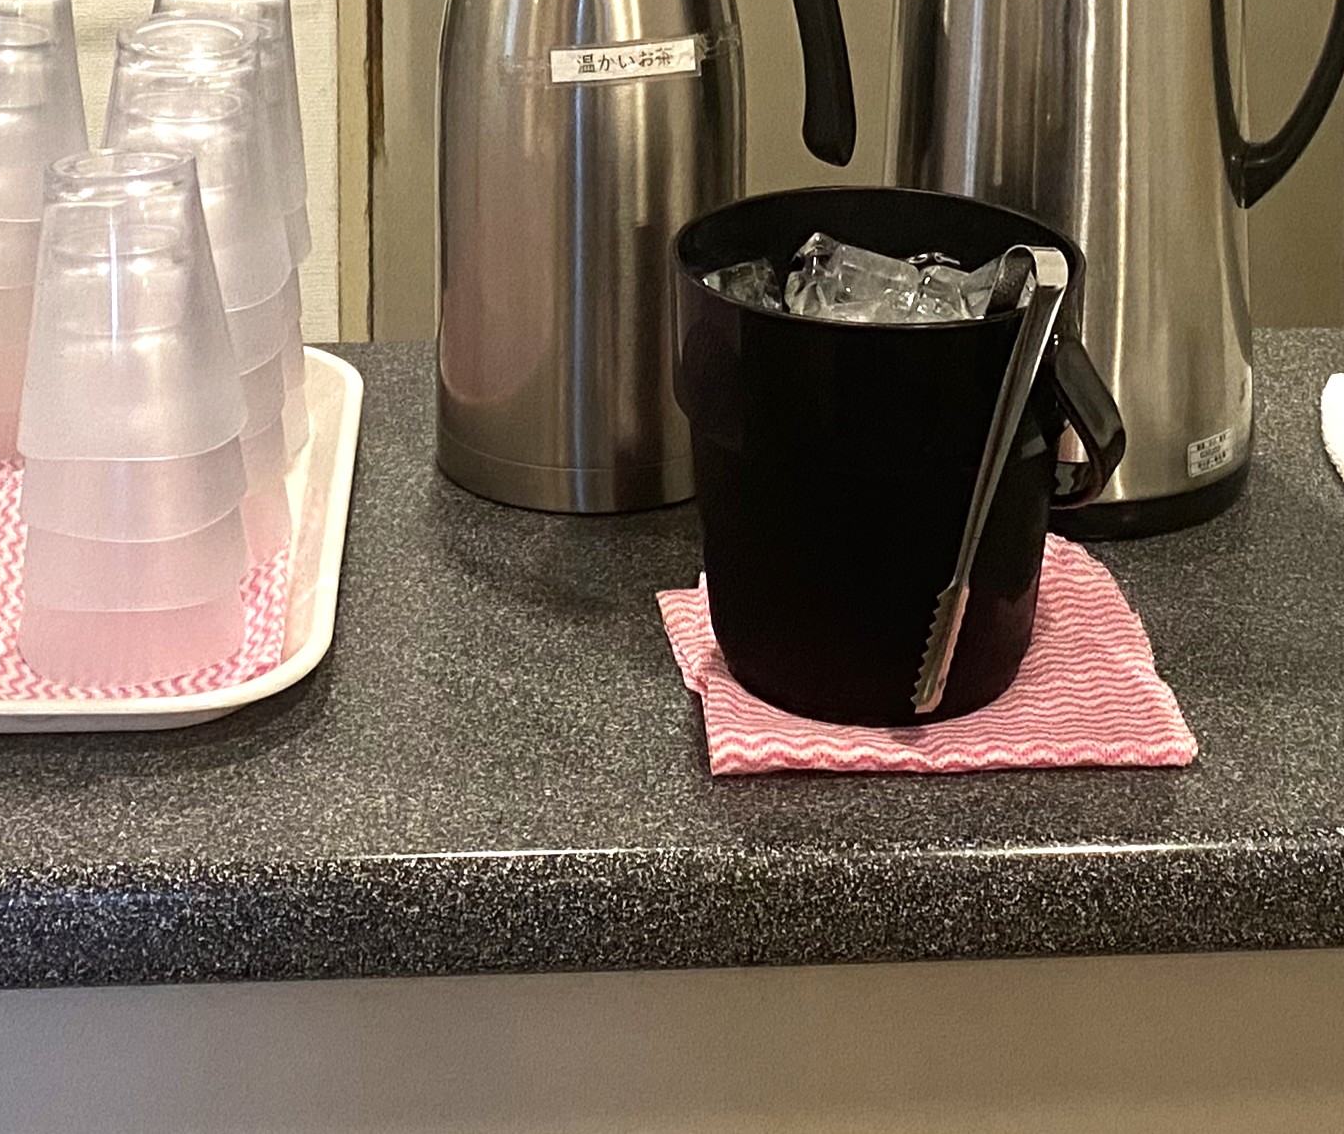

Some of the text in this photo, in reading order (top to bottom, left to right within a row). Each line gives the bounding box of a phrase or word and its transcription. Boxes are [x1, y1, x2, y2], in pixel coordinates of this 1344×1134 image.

[576, 47, 674, 75] 温かいお茶
